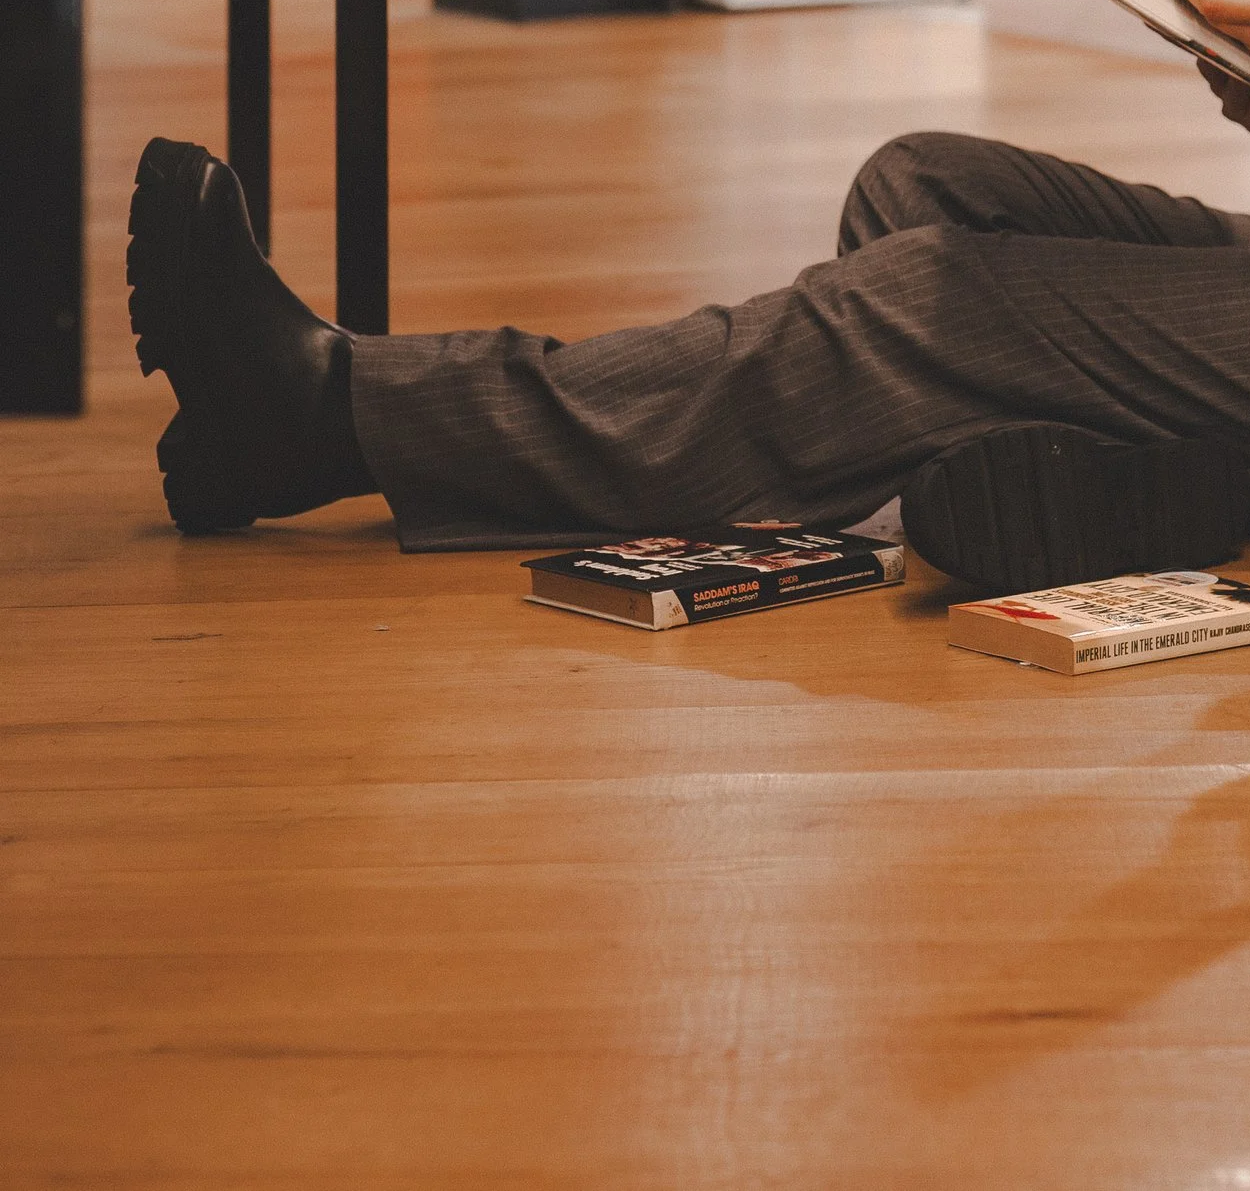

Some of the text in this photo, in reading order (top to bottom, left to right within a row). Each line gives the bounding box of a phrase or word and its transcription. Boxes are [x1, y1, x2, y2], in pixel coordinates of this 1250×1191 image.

[693, 579, 761, 603] SADDAM'S IRAQ
[1026, 593, 1077, 606] LIFE
[694, 597, 724, 612] Revolution
[724, 598, 731, 607] or
[730, 592, 760, 605] Reaction?
[1122, 602, 1154, 615] THE
[1133, 592, 1219, 615] EMERALD
[1075, 627, 1209, 664] IMPERIAL LIFE IN THE EMERALD CITY
